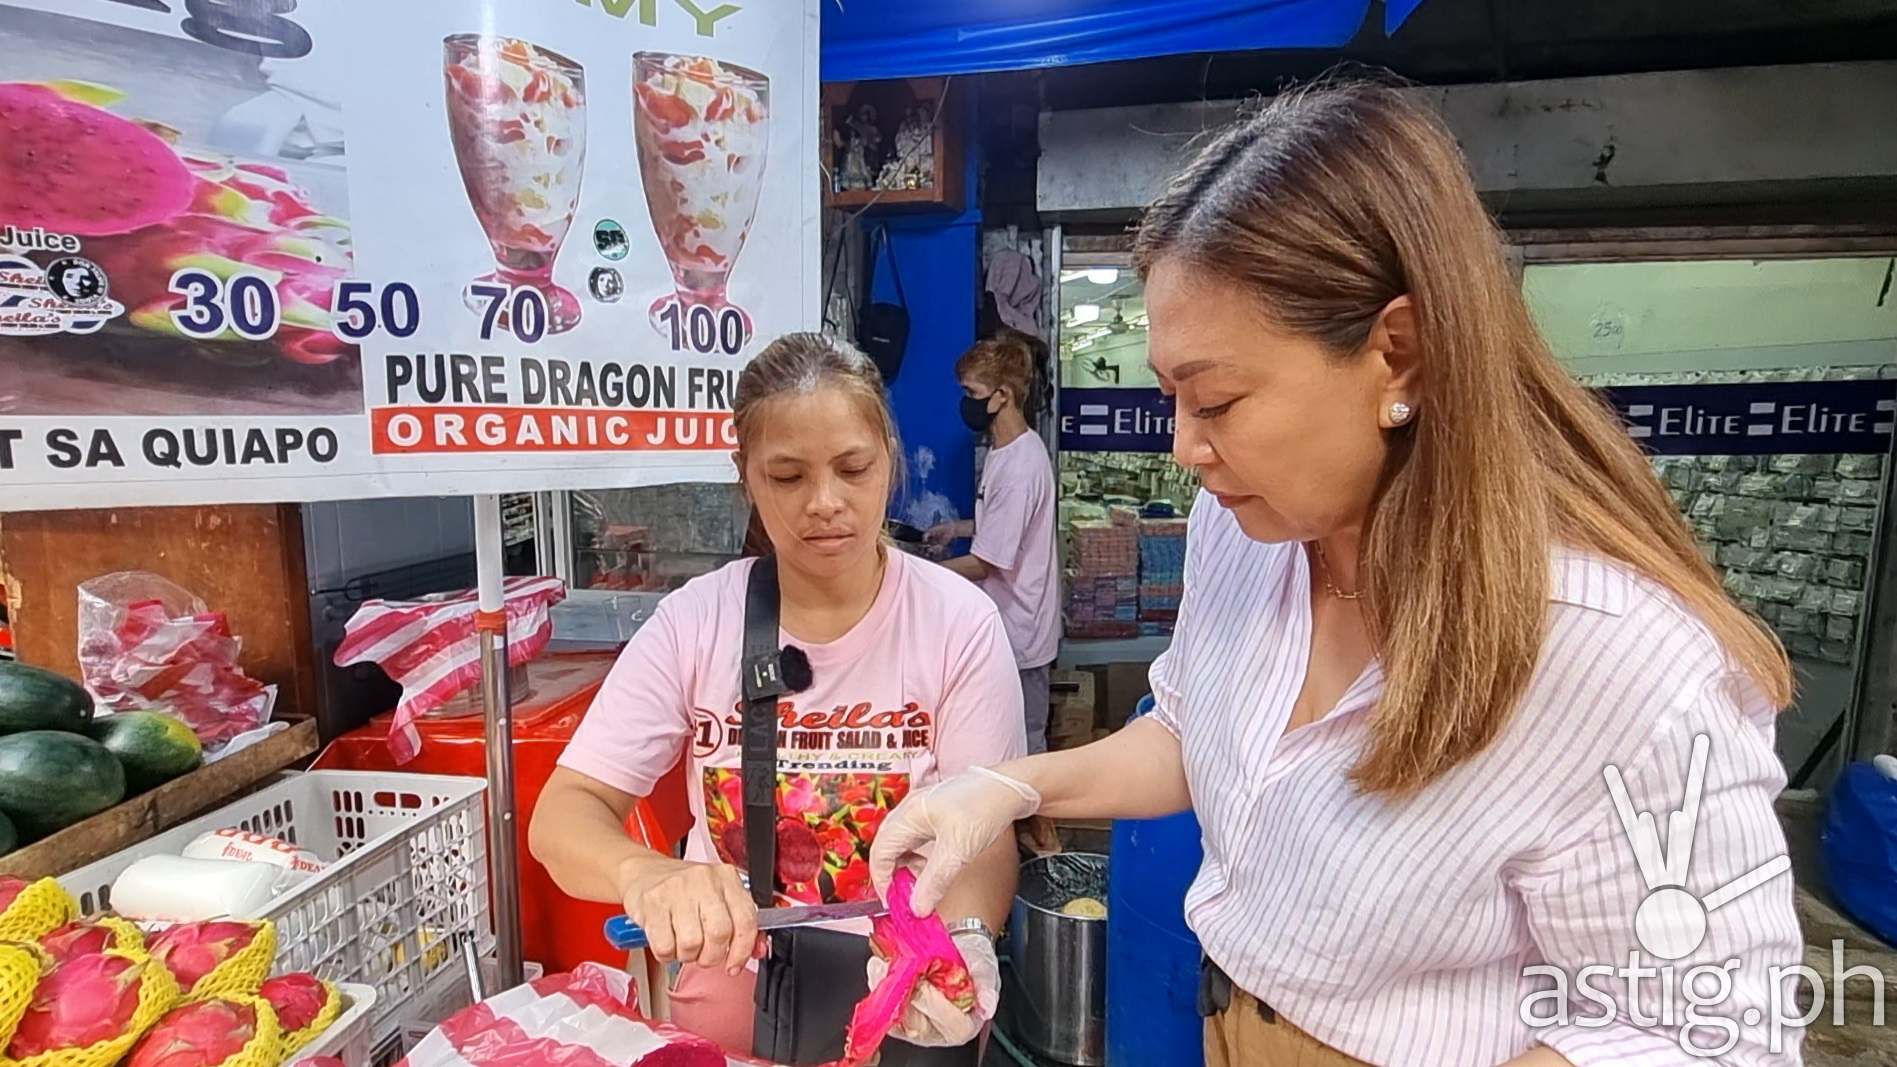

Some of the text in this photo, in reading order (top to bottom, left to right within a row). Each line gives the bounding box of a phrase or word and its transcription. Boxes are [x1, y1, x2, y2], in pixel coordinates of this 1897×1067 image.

[0, 226, 77, 251] Juice
[175, 272, 276, 335] 30
[337, 282, 420, 338] 50
[471, 285, 546, 343] 70
[660, 303, 744, 355] 100
[385, 354, 741, 410] PURE DRAGON FRU
[46, 428, 126, 469] SA
[142, 427, 339, 470] QUIAPO
[387, 413, 739, 447] ORGANIC JUIC
[725, 701, 931, 729] heila's
[791, 731, 833, 749] FRUIT
[836, 730, 881, 749] SALAD
[886, 732, 898, 749] &
[777, 760, 893, 772] Trending
[291, 855, 325, 873] IDEA
